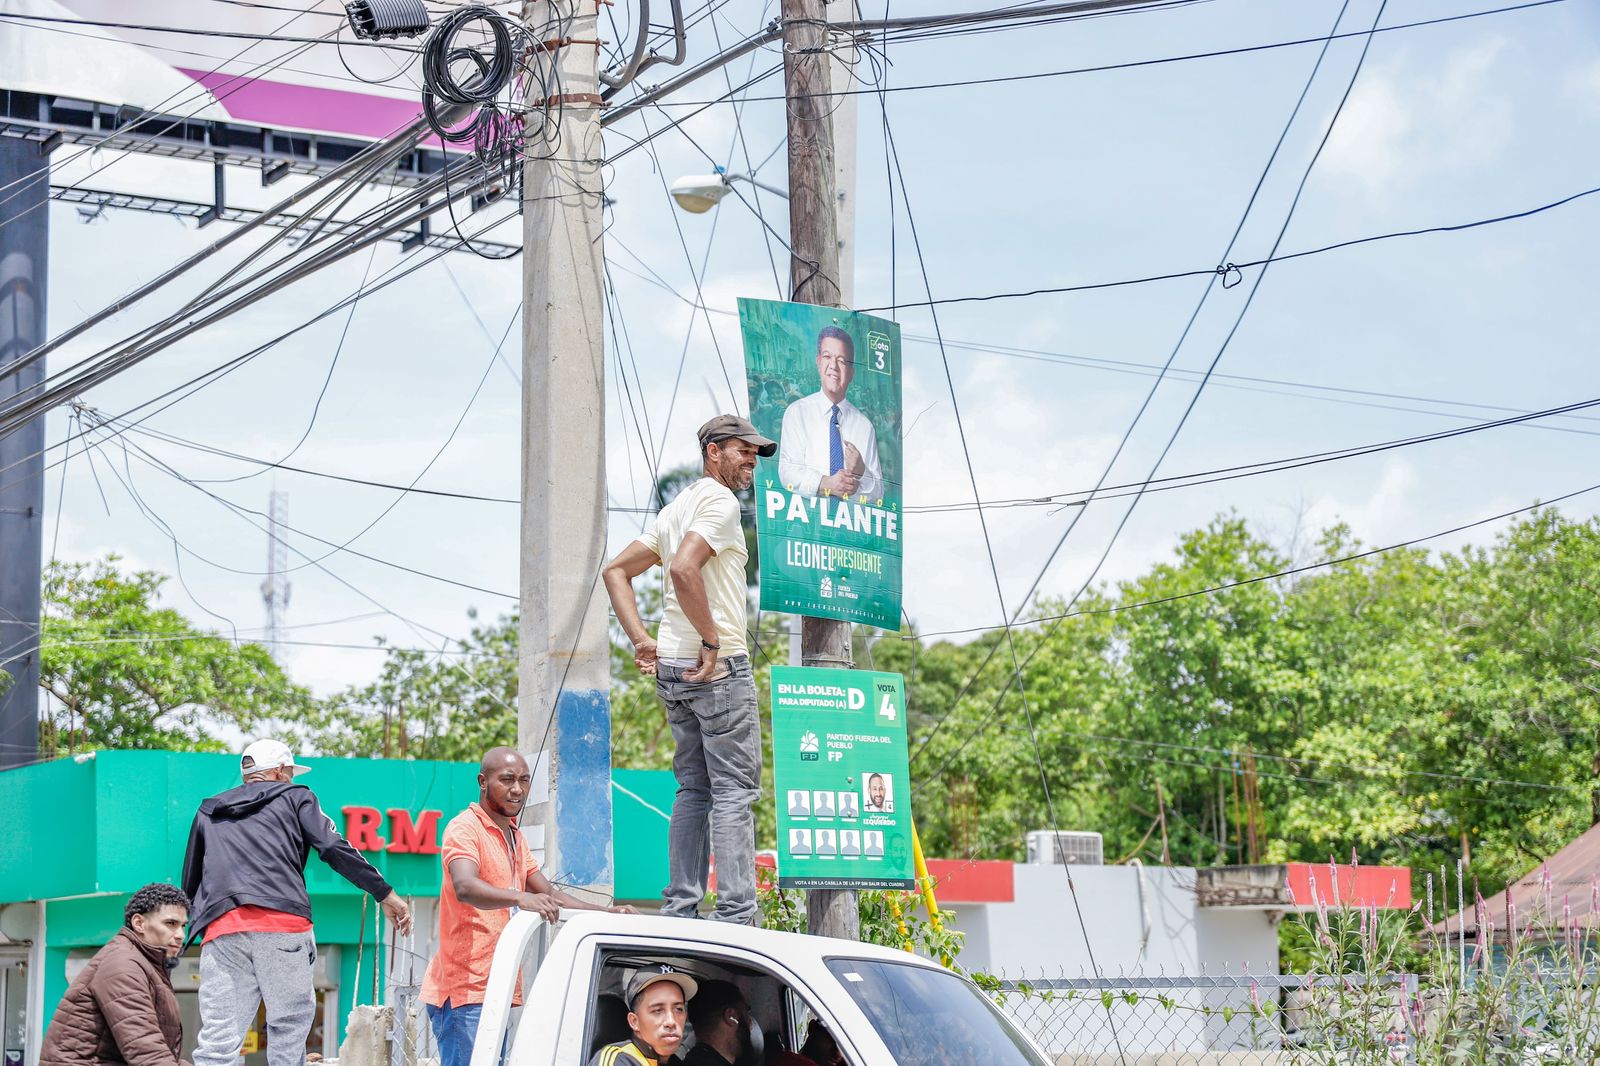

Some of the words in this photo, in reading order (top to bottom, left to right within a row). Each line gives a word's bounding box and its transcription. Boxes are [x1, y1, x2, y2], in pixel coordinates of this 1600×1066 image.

[875, 351, 885, 370] 3
[765, 489, 897, 540] PA'LANTE
[787, 540, 836, 571] LEONEL
[831, 546, 882, 574] PRESIDENTE
[778, 684, 791, 694] EN
[793, 684, 806, 695] LA
[807, 685, 846, 697] BOLETA:
[877, 684, 896, 693] VOTA
[778, 697, 799, 706] PARA
[799, 698, 835, 708] DIPUTADO
[847, 687, 865, 710] D
[879, 693, 896, 721] 4
[826, 733, 854, 742] PARTIDO
[854, 734, 879, 743] FUERZA
[880, 736, 892, 744] DEL
[826, 741, 853, 750] PUEBLO
[801, 753, 818, 761] FP
[827, 751, 843, 762] FP
